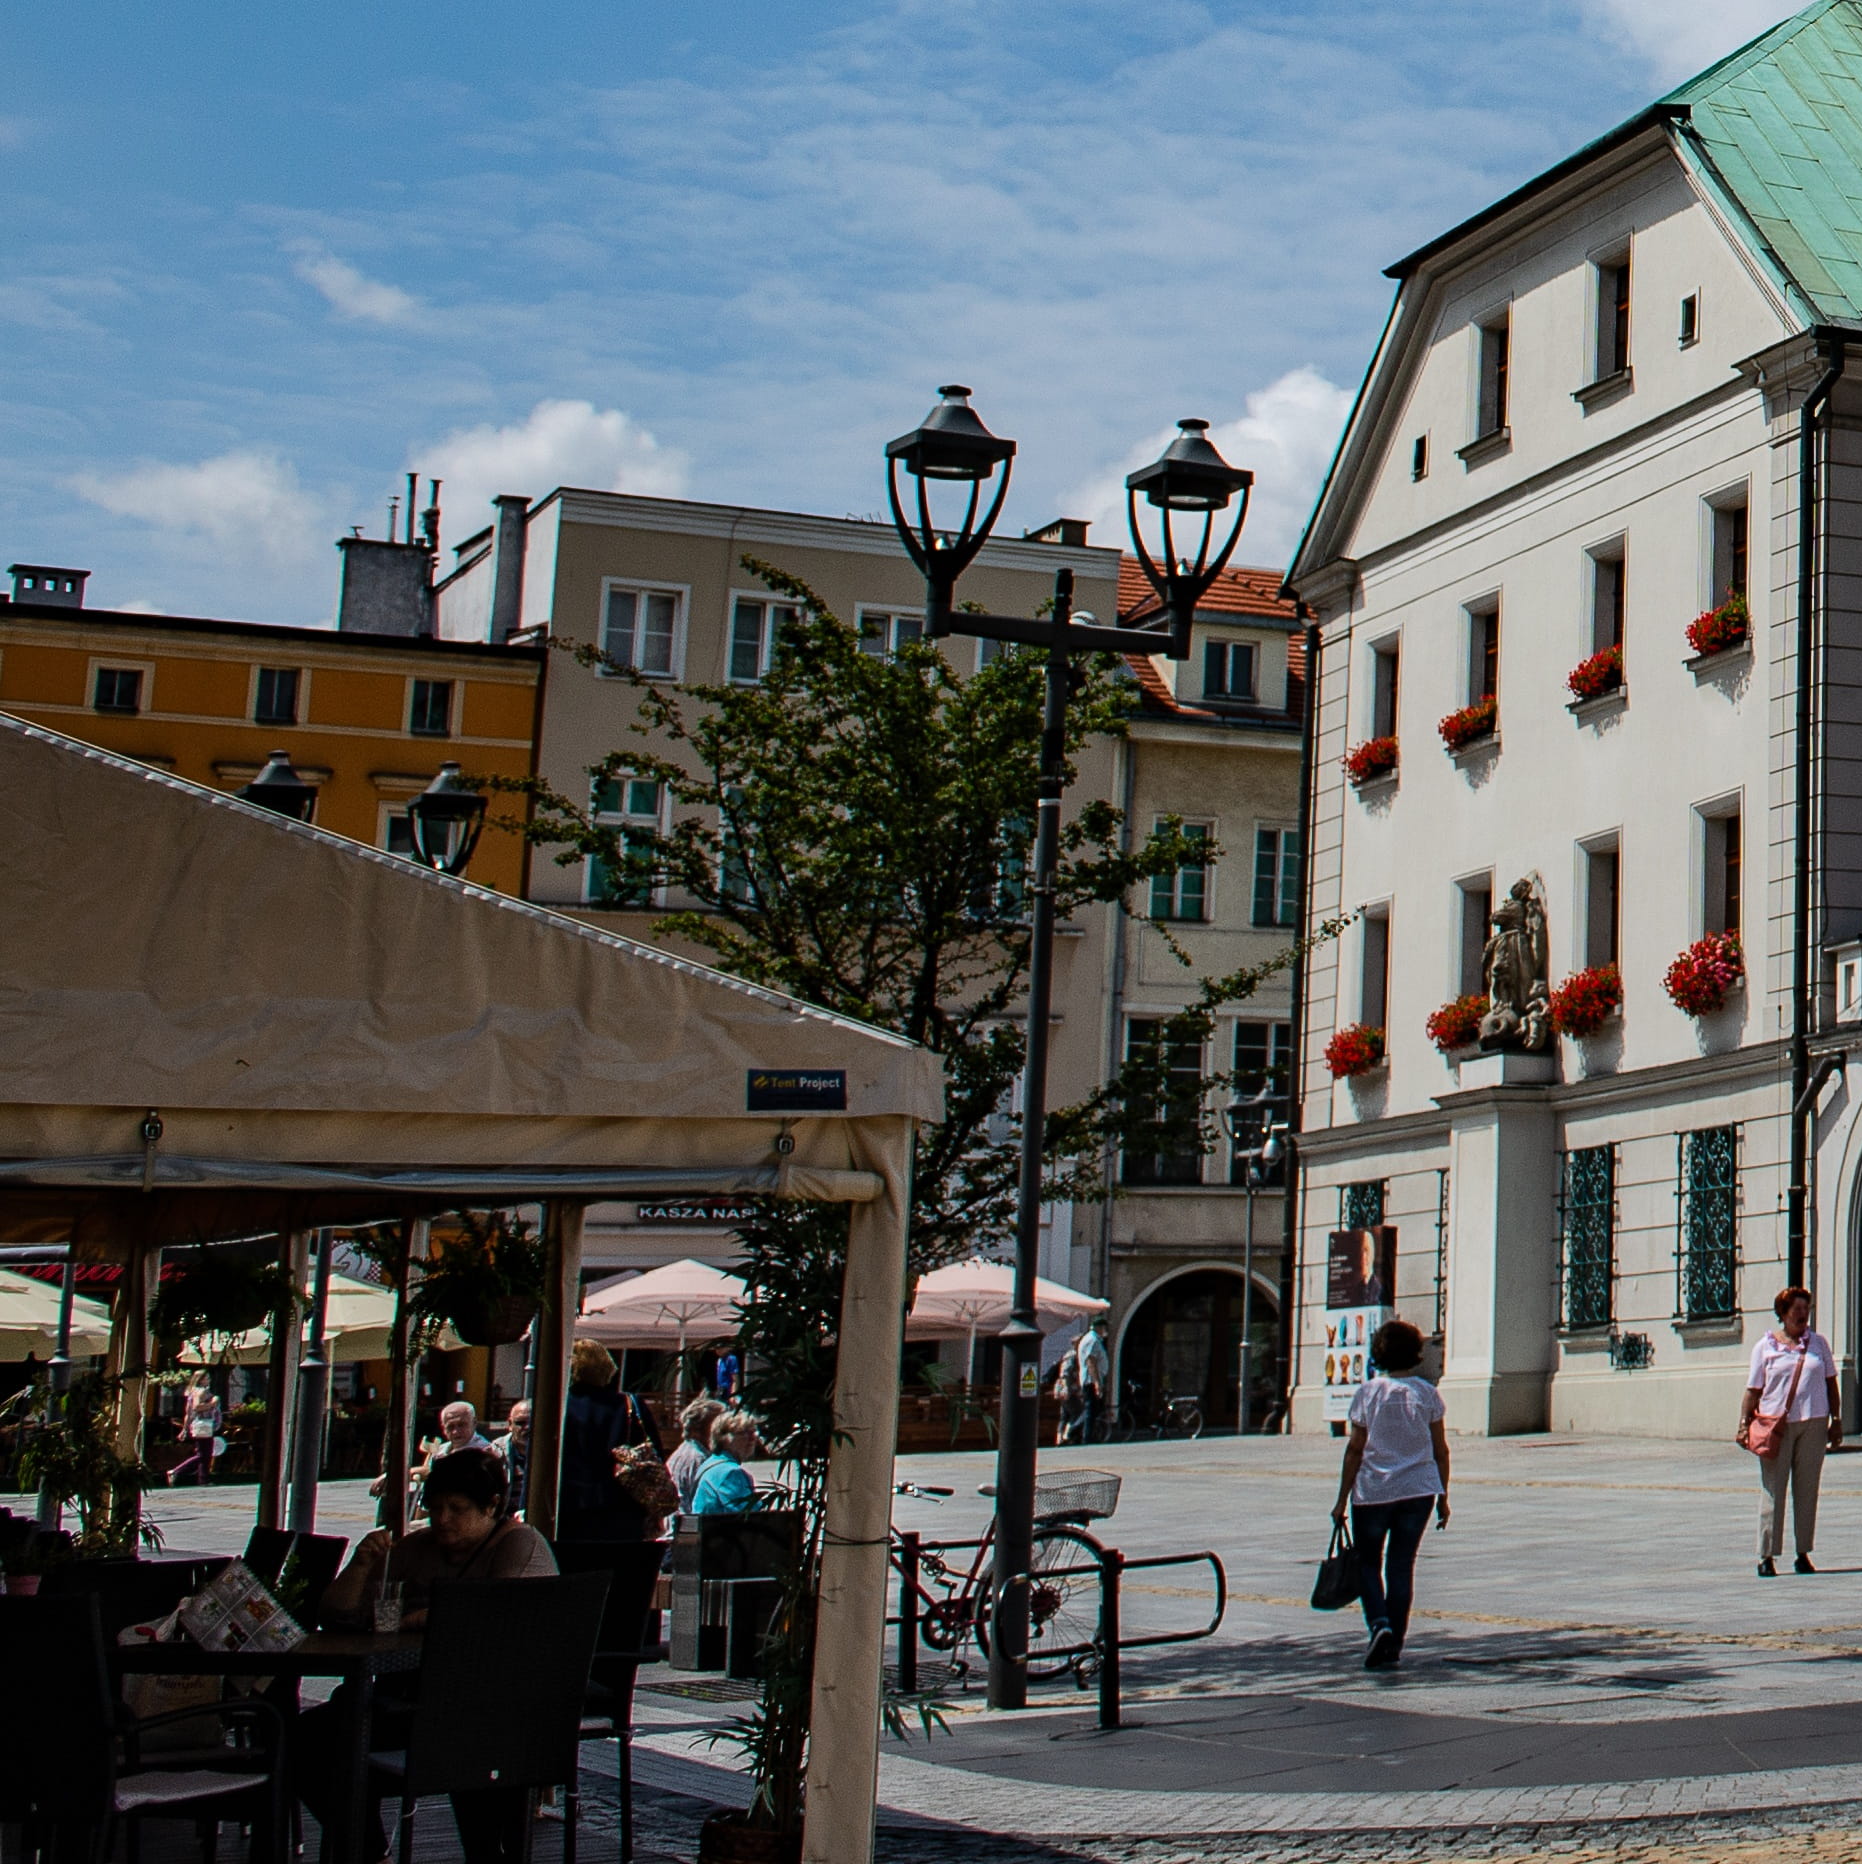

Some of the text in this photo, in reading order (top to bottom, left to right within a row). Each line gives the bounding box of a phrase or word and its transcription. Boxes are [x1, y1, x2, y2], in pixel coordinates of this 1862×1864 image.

[772, 1076, 840, 1091] Tent Project
[640, 1207, 707, 1219] KASZA
